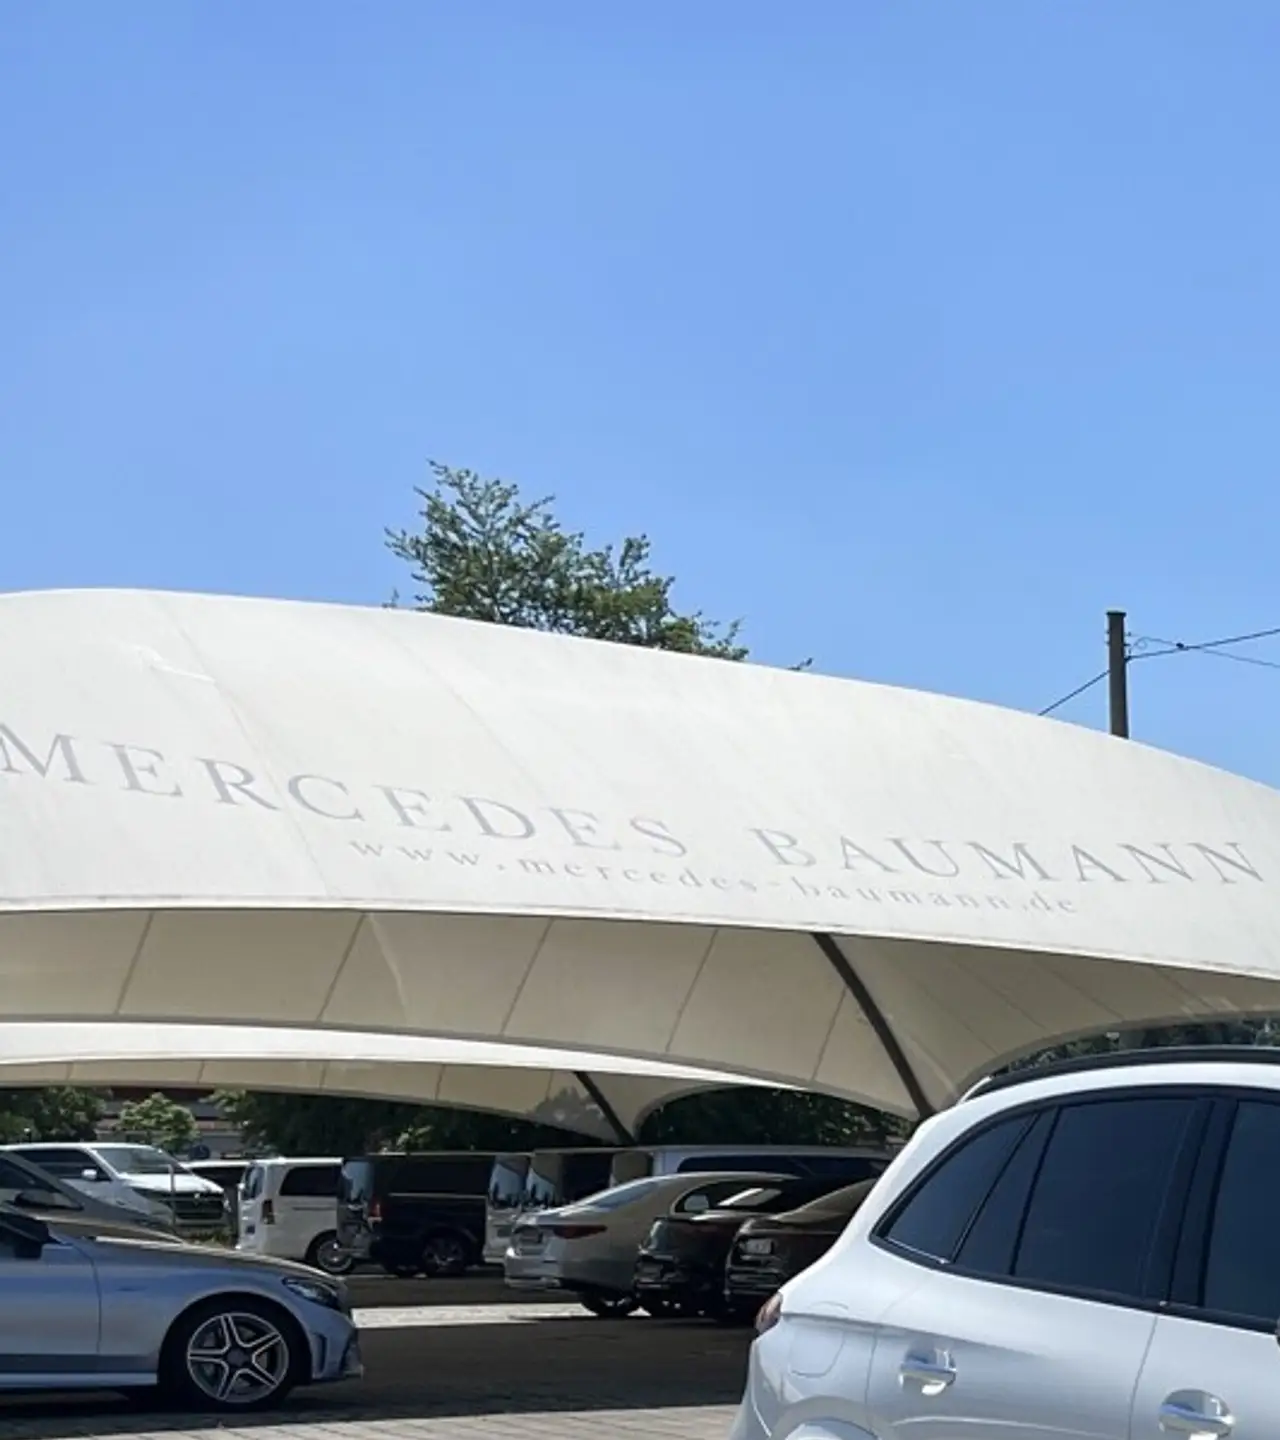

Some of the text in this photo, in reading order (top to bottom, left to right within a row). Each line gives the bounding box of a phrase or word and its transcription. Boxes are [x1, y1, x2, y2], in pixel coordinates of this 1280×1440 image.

[0, 722, 1266, 886] MERCEDES BAUMANN
[349, 838, 1078, 914] www.mercedes-baumann.de
